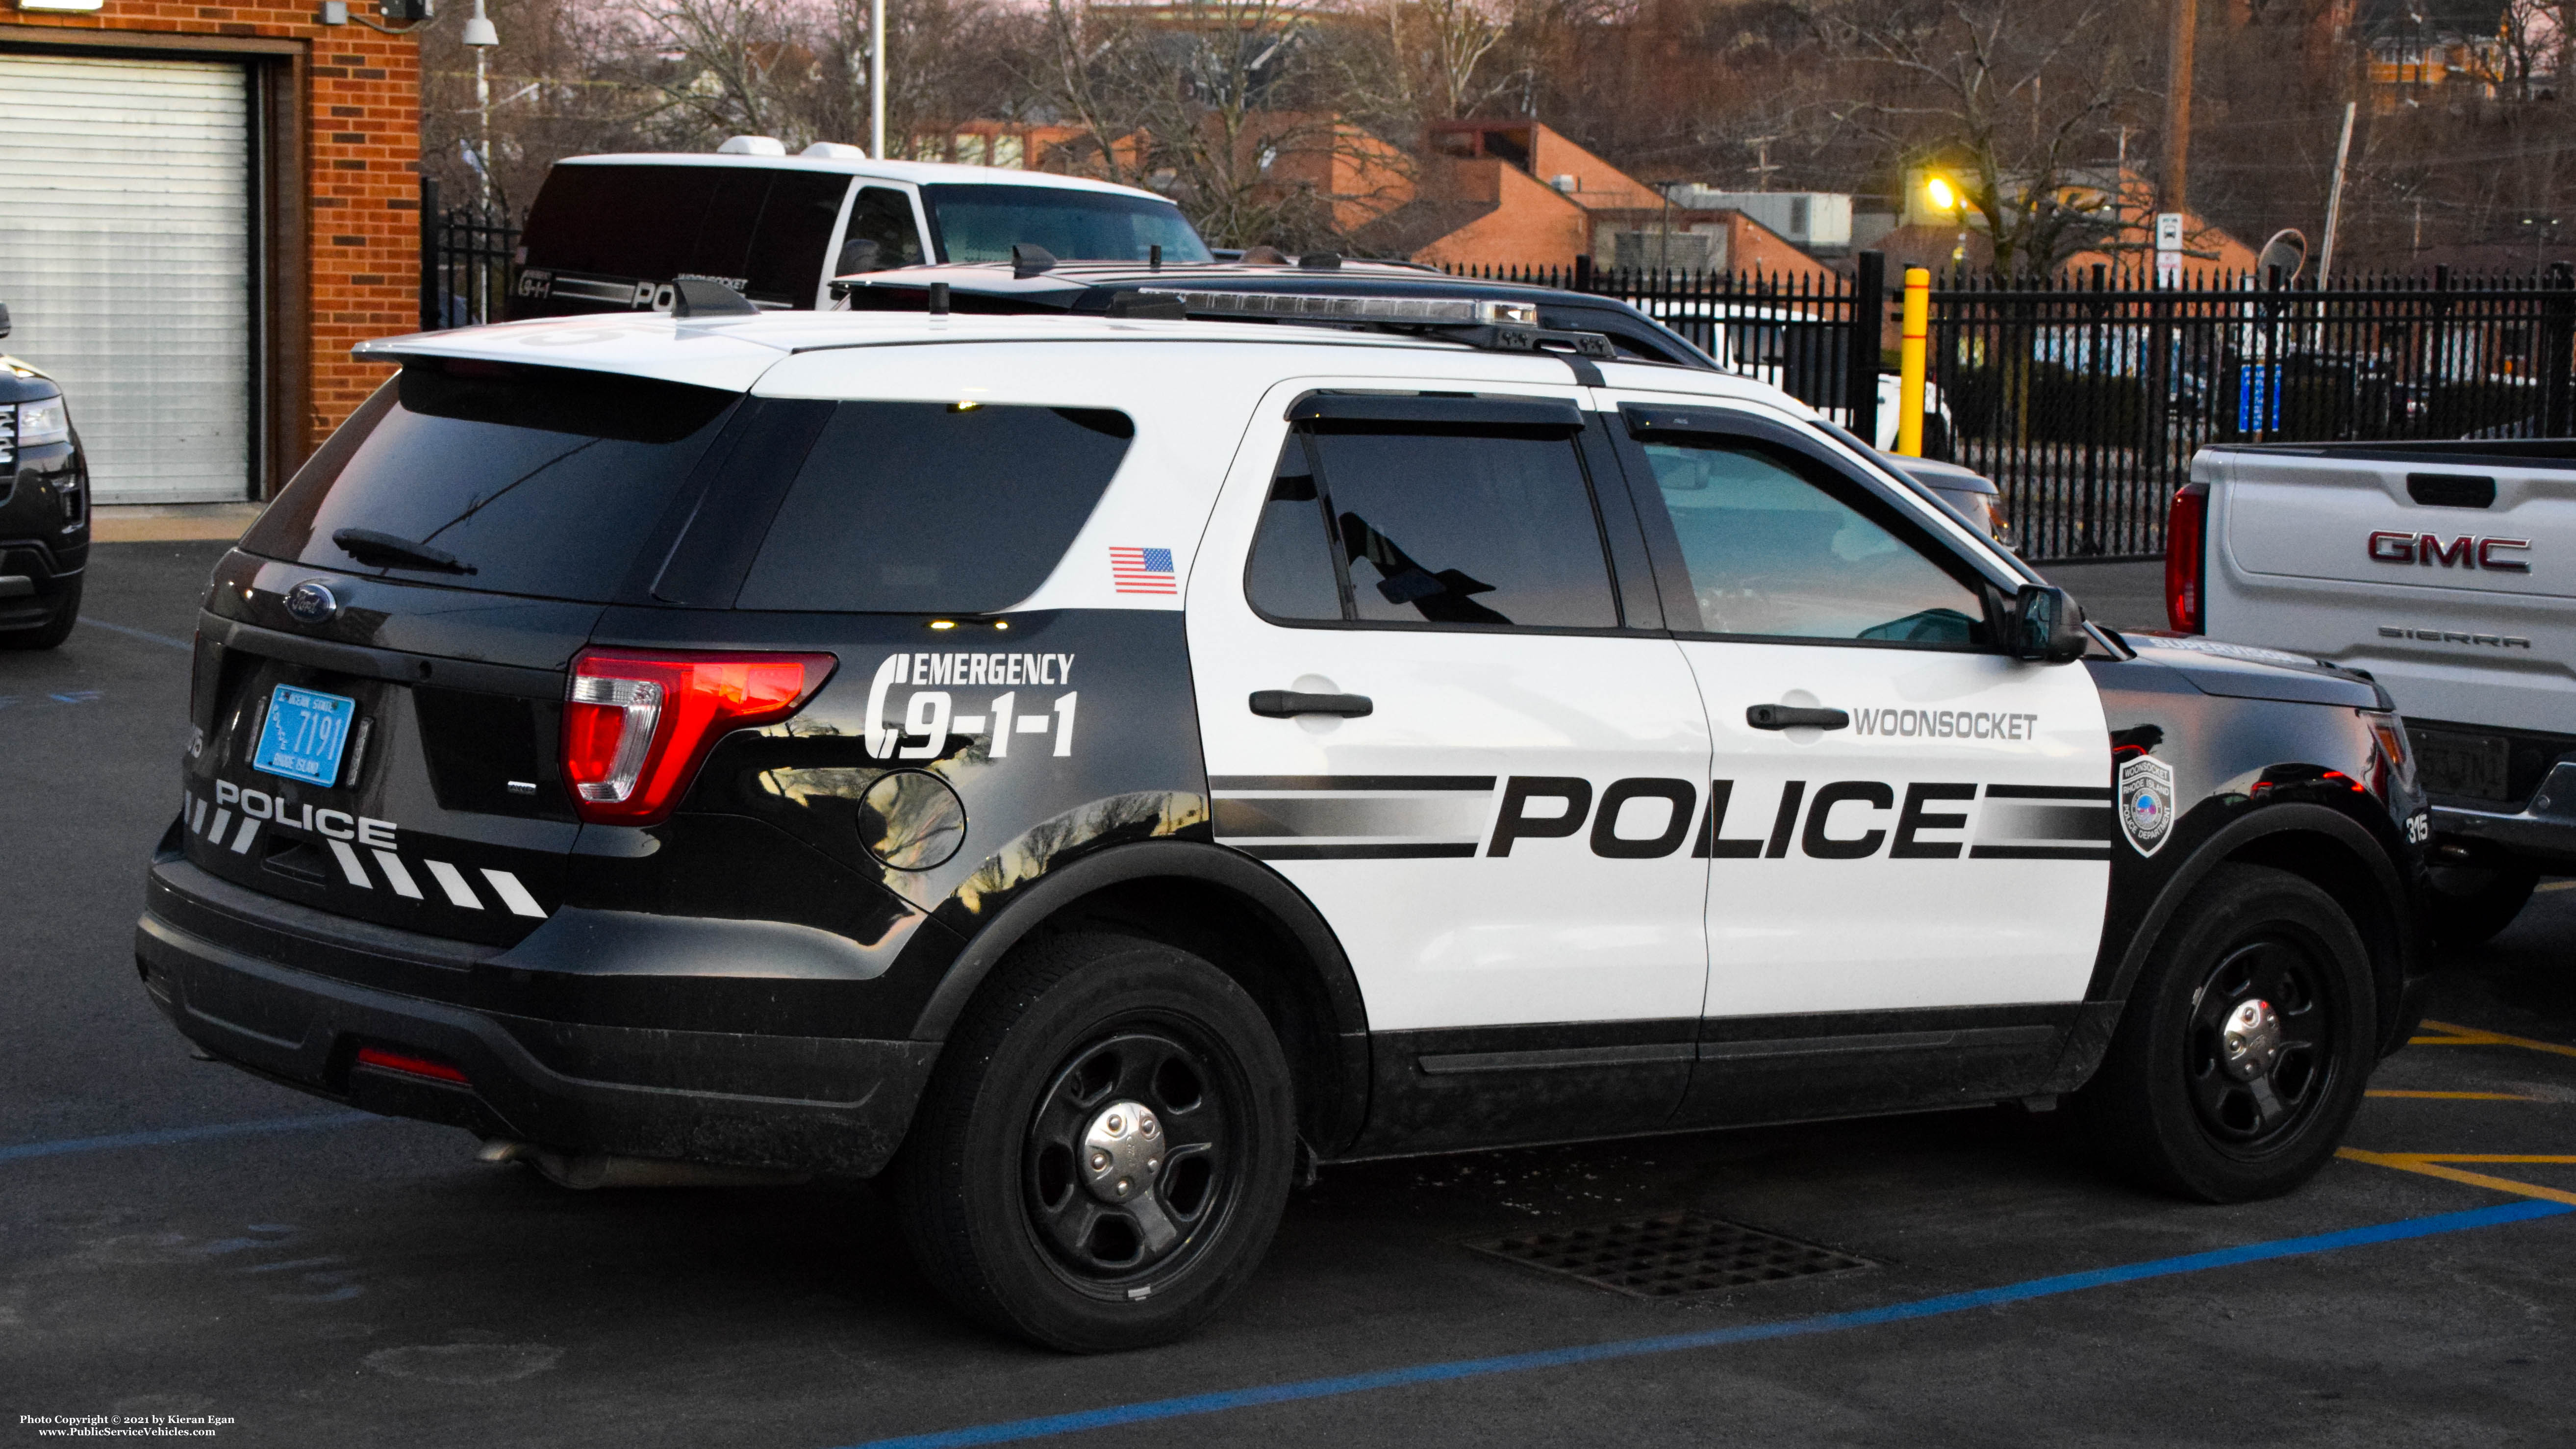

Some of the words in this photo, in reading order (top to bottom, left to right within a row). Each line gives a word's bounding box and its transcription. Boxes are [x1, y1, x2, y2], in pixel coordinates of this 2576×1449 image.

[2368, 530, 2531, 573] GMC
[292, 589, 320, 614] Ford
[2378, 627, 2530, 648] SIERRA
[912, 653, 1075, 685] EMERGENCY
[294, 711, 342, 760] 7191
[899, 691, 1077, 759] 9-1-1
[1854, 708, 2038, 740] WOONSOCKET
[2124, 762, 2168, 779] WOONSOCKET
[2123, 780, 2144, 794] RHODE
[2146, 779, 2169, 796] ISLAND
[216, 779, 397, 850] POLICE
[1486, 776, 1978, 859] POLICE
[2123, 804, 2137, 835] POLICE
[2138, 807, 2171, 839] DEPARTMENT
[2406, 813, 2428, 844] 315
